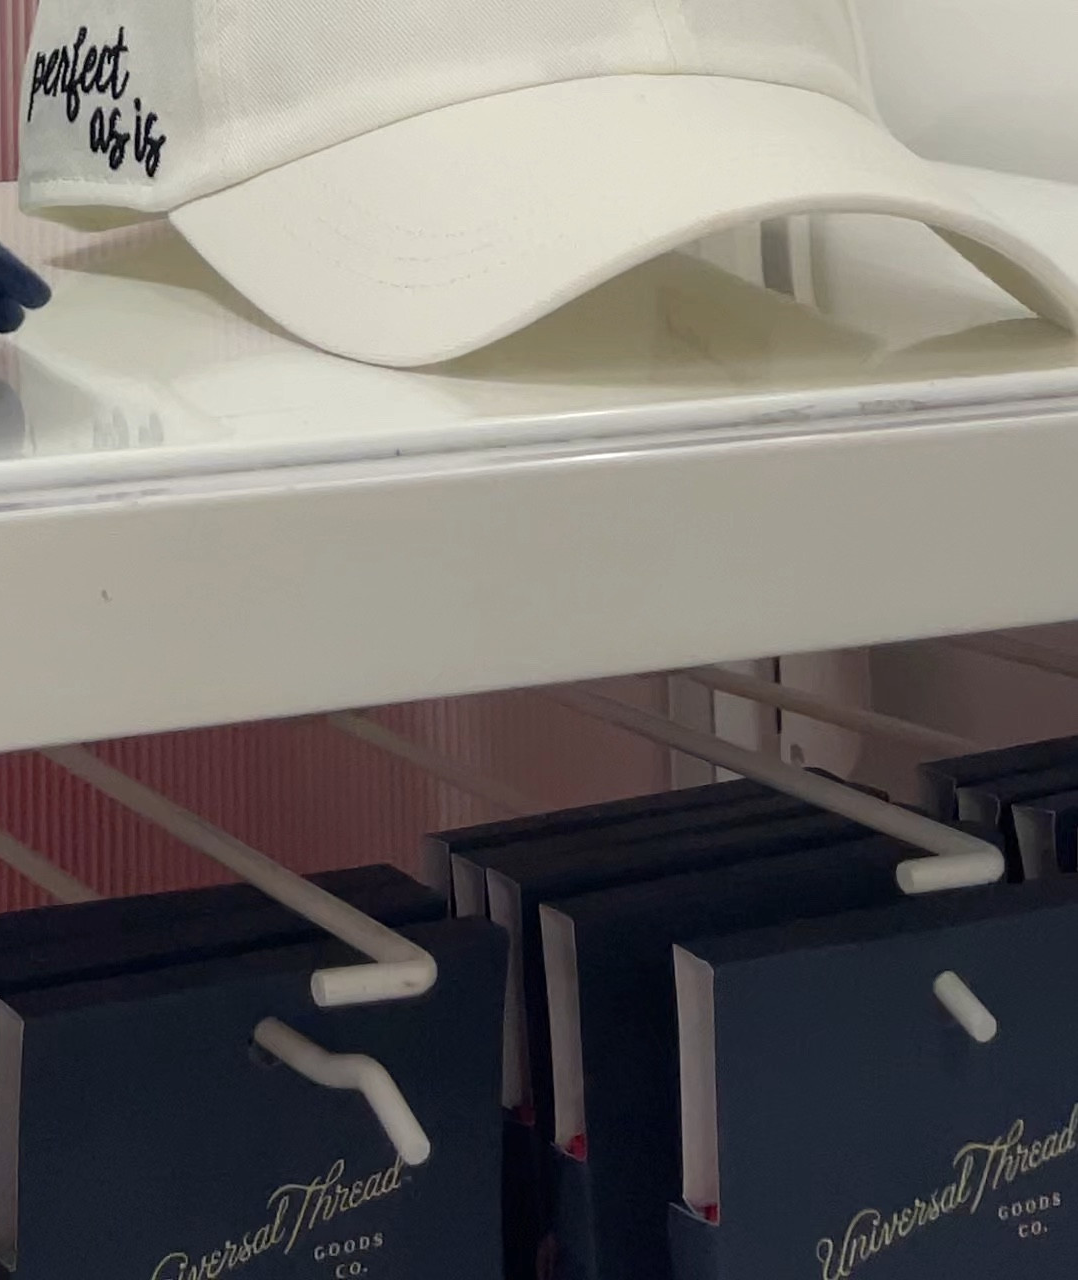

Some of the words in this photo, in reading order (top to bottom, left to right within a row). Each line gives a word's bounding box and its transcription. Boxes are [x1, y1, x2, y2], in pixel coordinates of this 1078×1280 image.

[27, 26, 130, 123] perfect
[89, 106, 130, 170] as
[133, 97, 167, 178] is
[266, 1156, 406, 1255] Thread
[817, 1154, 973, 1280] Universal
[953, 1102, 1078, 1215] Thread
[998, 1192, 1061, 1221] GOODS
[1018, 1221, 1048, 1238] CO.
[313, 1233, 384, 1260] GOODS
